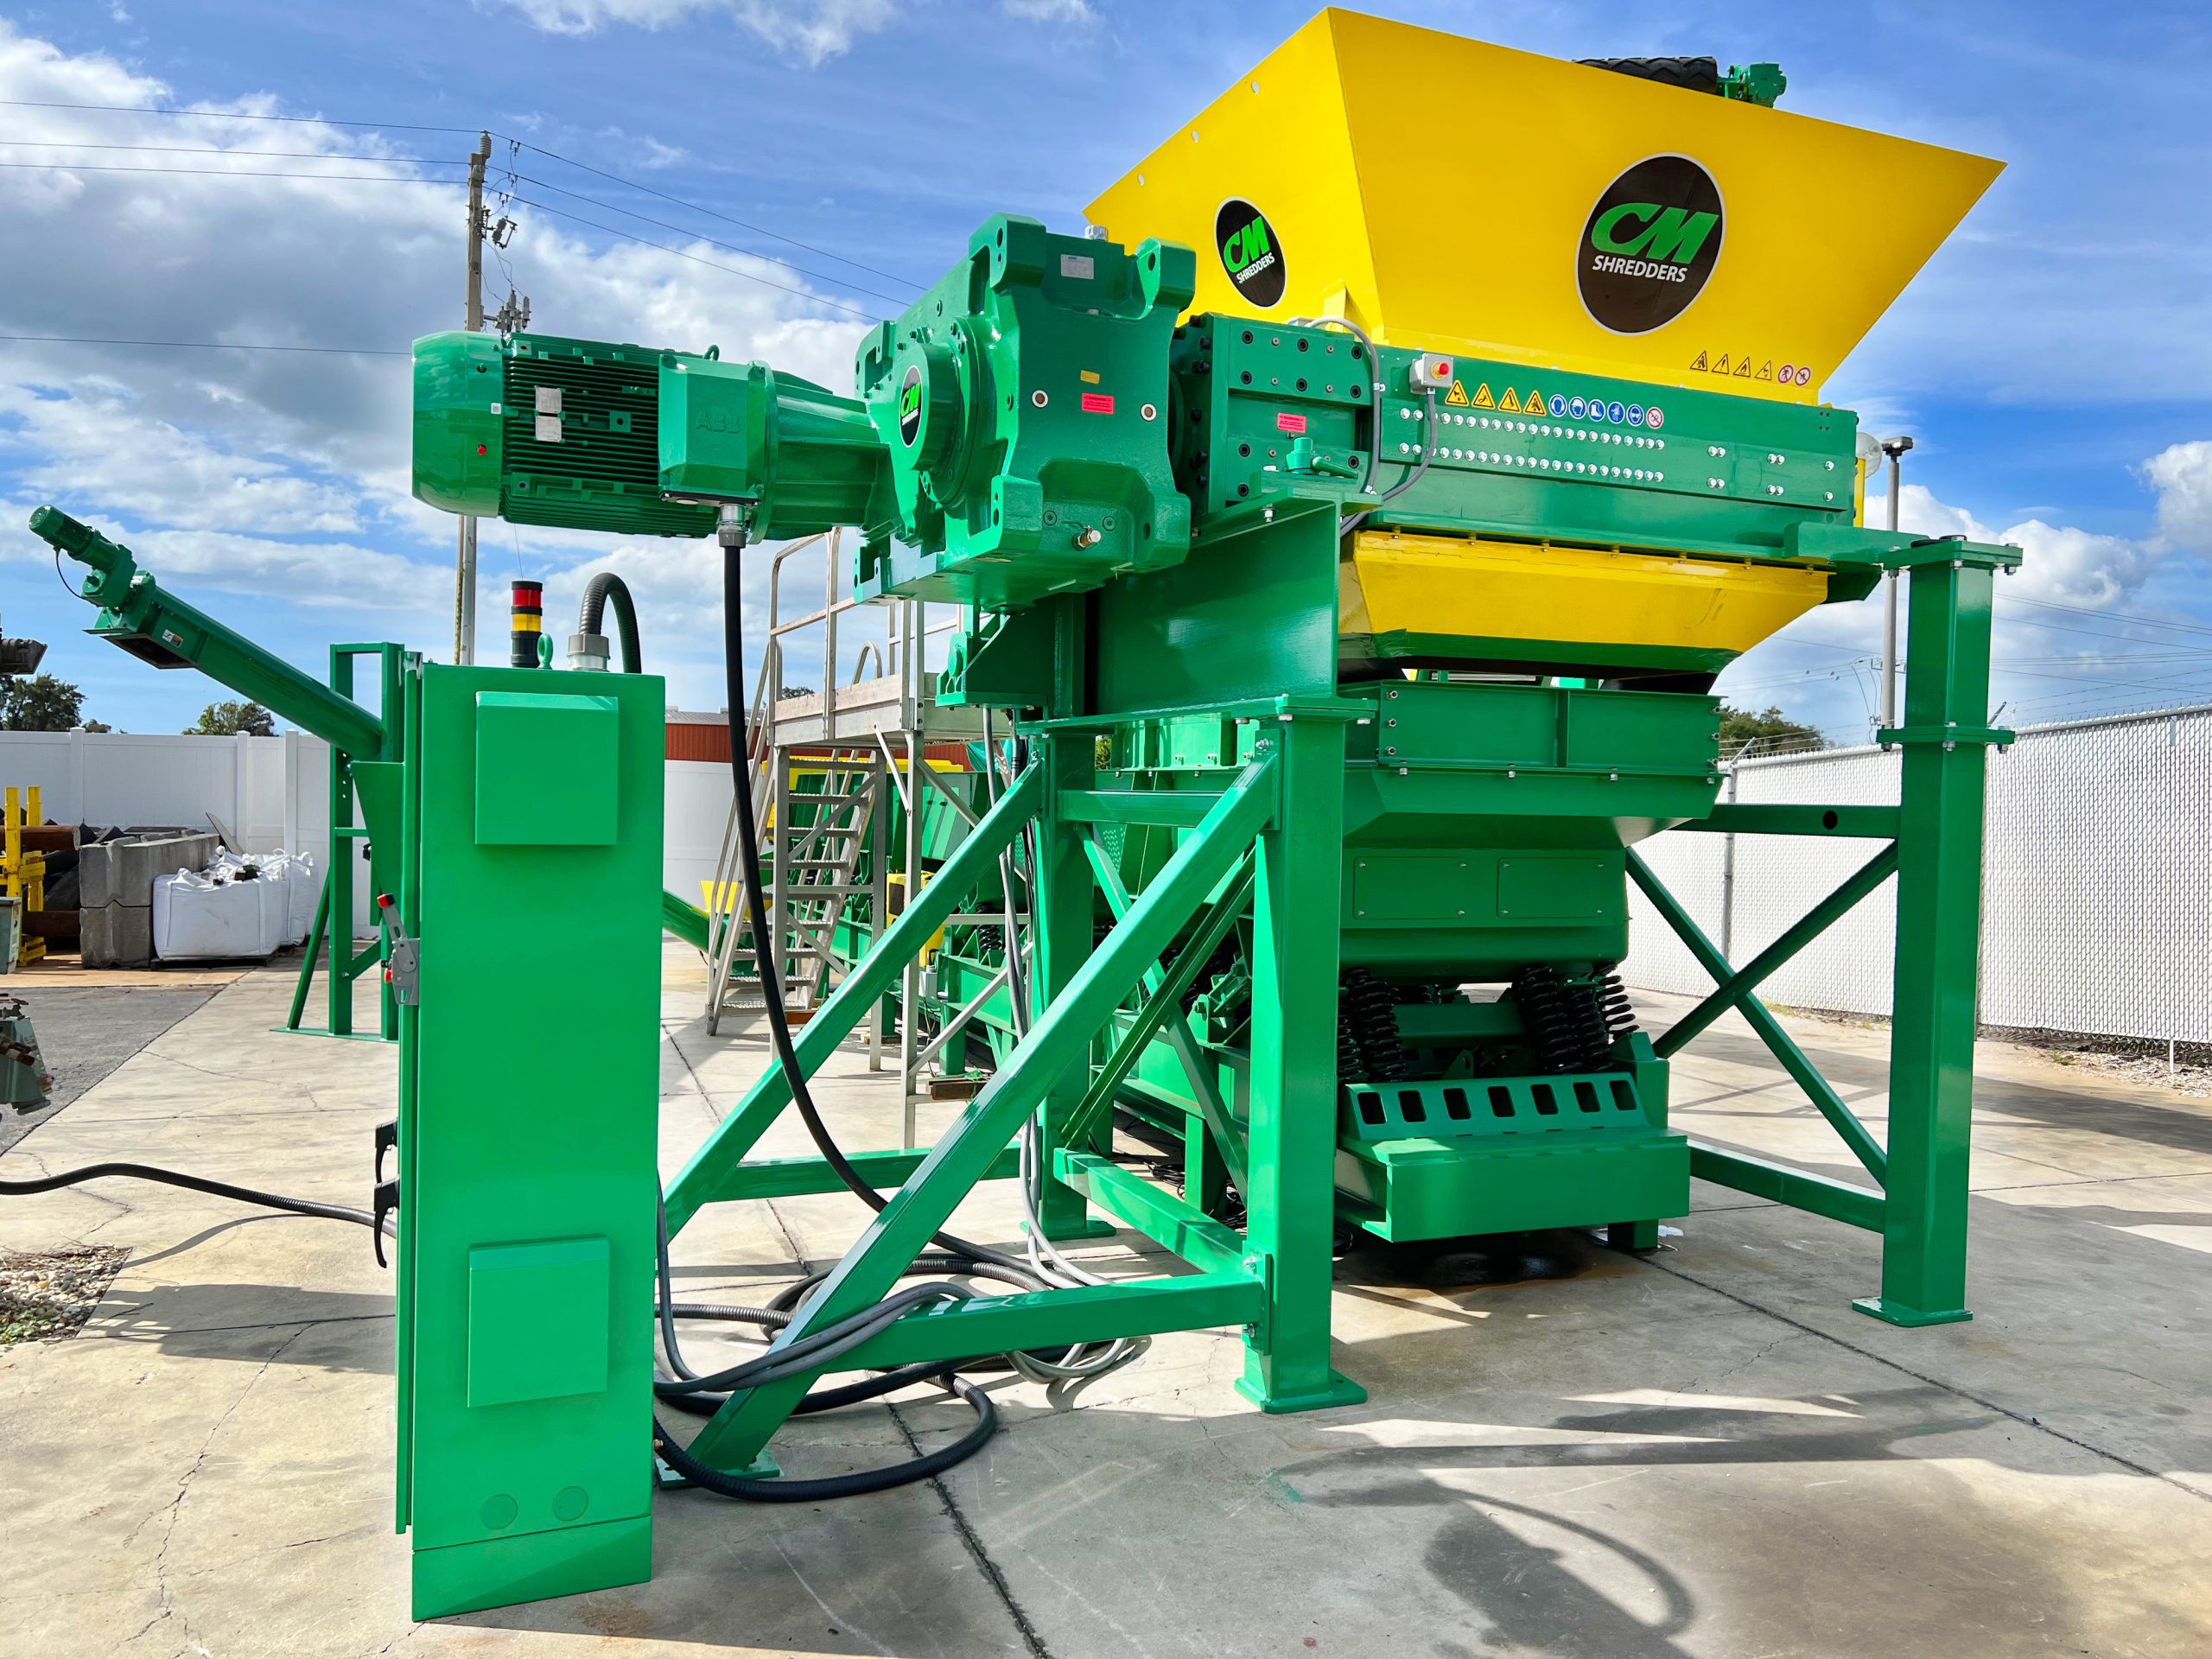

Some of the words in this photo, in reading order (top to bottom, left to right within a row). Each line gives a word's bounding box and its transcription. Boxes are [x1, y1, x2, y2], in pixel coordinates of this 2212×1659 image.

[1223, 215, 1271, 274] CM
[1591, 202, 1719, 264] CM
[1236, 251, 1275, 284] SHREDDERS
[1592, 255, 1688, 283] SHREDDERS
[900, 382, 921, 418] CM
[694, 411, 741, 434] ABB
